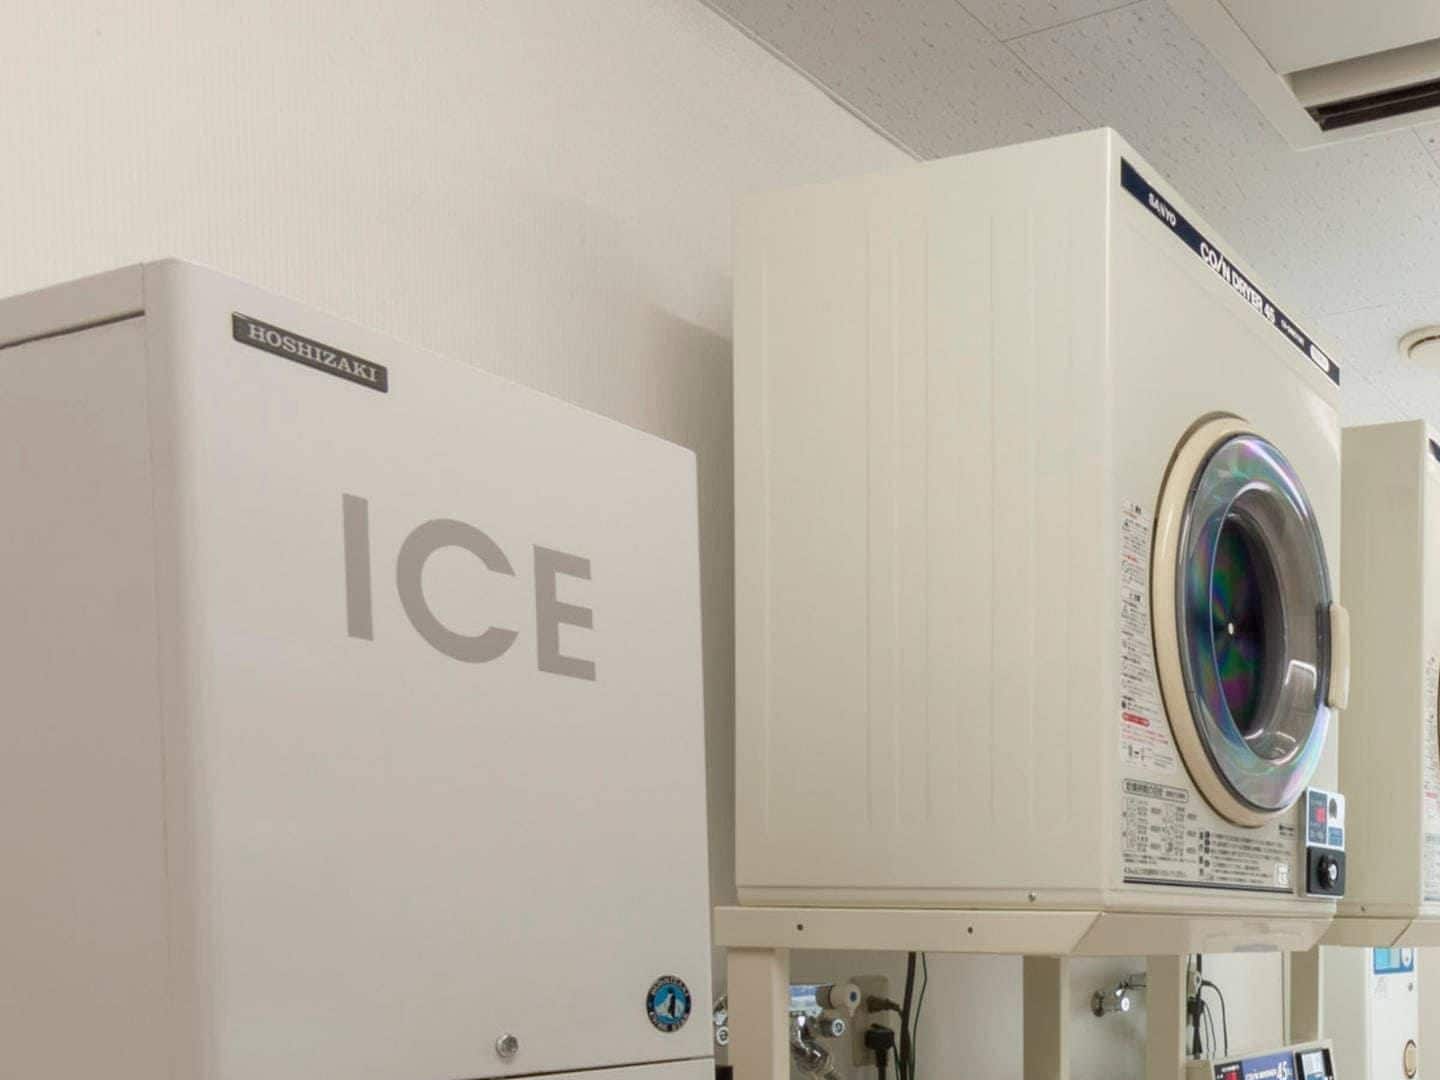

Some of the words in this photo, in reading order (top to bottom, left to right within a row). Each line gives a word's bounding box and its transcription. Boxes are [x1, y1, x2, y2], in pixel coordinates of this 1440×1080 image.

[1148, 192, 1177, 228] SANYO
[247, 321, 378, 384] HOSHIZAKI
[341, 492, 597, 682] ICE
